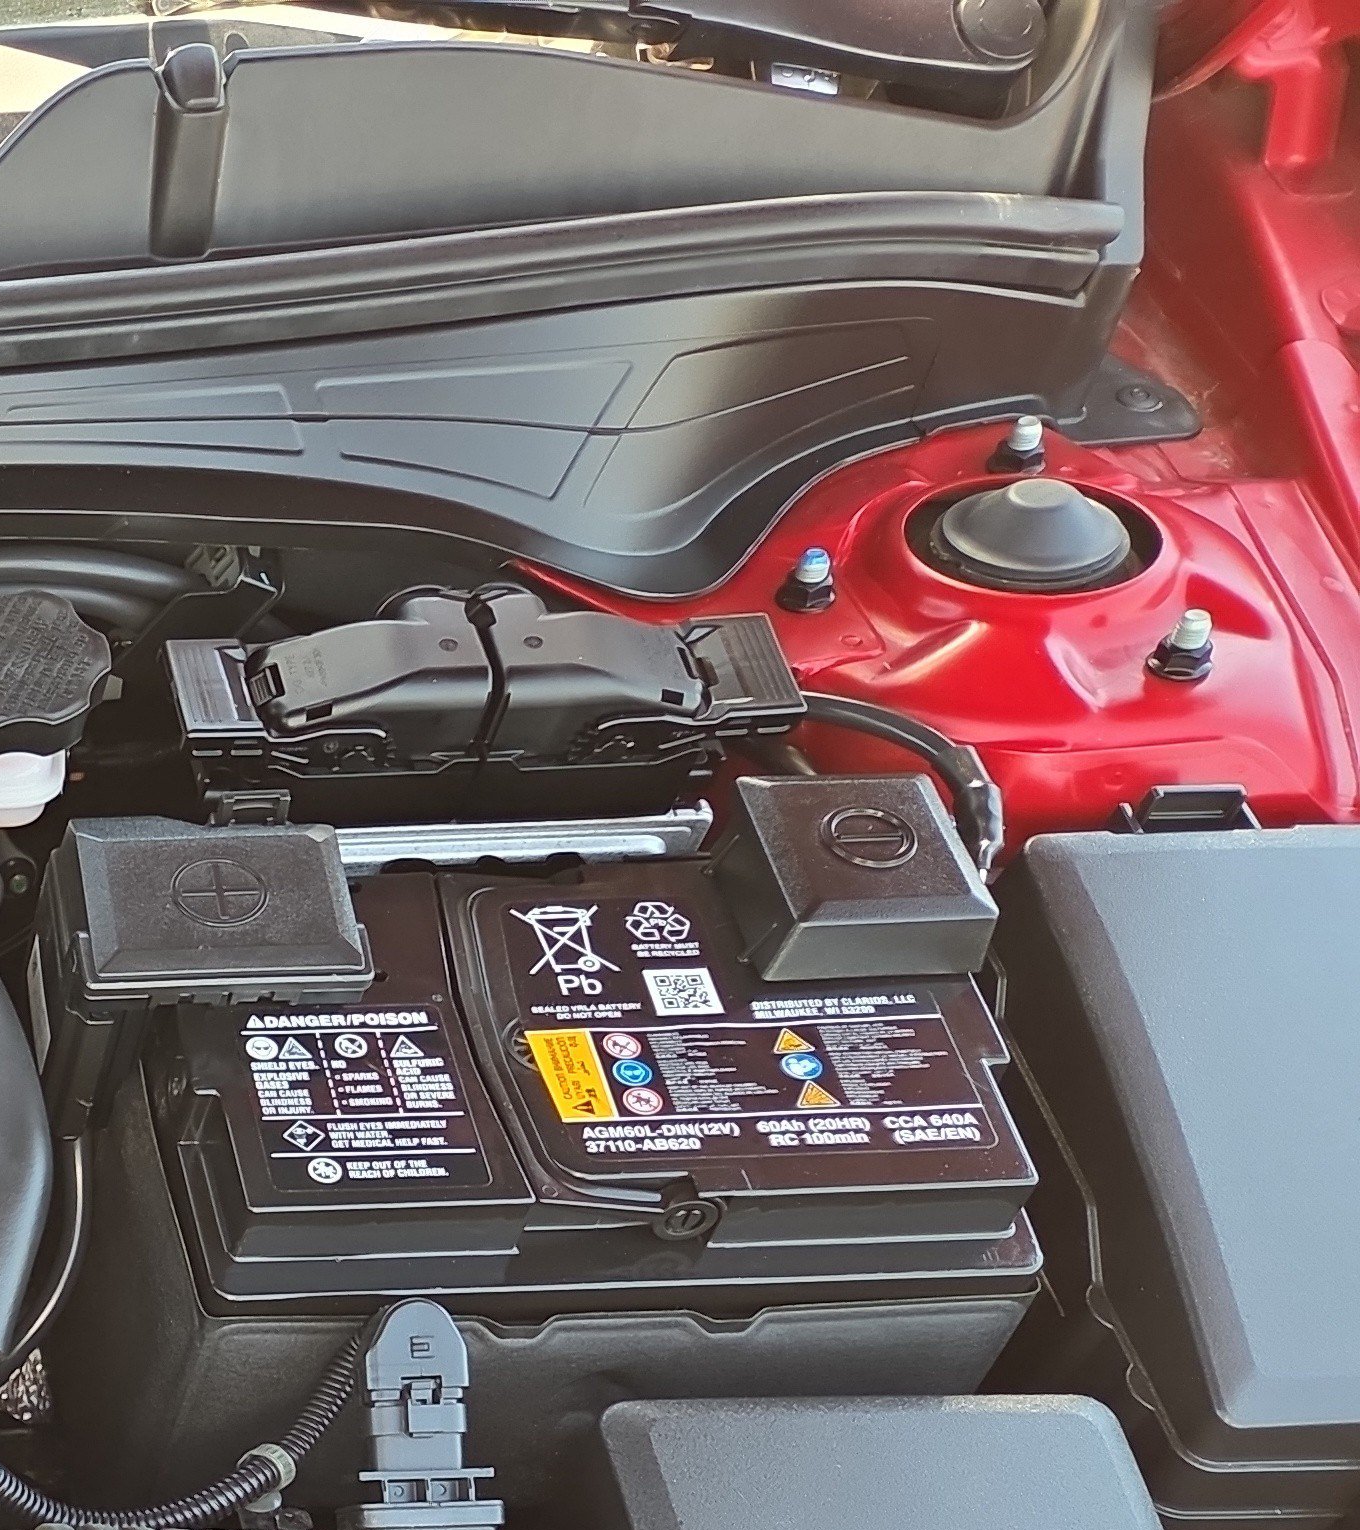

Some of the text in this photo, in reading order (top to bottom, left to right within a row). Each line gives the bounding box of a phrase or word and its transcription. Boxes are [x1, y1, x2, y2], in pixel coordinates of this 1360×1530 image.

[652, 949, 701, 958] RECYCLED
[557, 974, 603, 996] Pb
[751, 999, 823, 1011] DISTRIBUTED
[825, 998, 839, 1007] BY
[895, 994, 917, 1004] LLC
[531, 1002, 642, 1014] SEALED VRLA BATTERY
[754, 1008, 824, 1020] MILWAUKEE,
[825, 1006, 841, 1016] WI
[263, 1011, 429, 1029] DANGER/POISON
[556, 1010, 623, 1020] DO NOT OPEN
[250, 1061, 320, 1071] SHIELD EYES.
[330, 1060, 347, 1069] NO
[393, 1057, 445, 1067] SULFURIC
[342, 1072, 380, 1081] SPARKS
[396, 1067, 422, 1076] ACID
[253, 1072, 310, 1082] EXPLOSIVE
[398, 1074, 451, 1084] CAN CAUSE
[345, 1084, 384, 1093] FLAMES
[401, 1082, 454, 1092] BLINDNESS
[257, 1088, 310, 1098] CAN CAUSE
[404, 1091, 456, 1100] OR SEVERE
[260, 1098, 312, 1107] BLINDNESS
[348, 1097, 394, 1107] SMOKING
[262, 1106, 315, 1115] OR INJURY.
[326, 1119, 447, 1131] FLUSH EYES IMMEDIATELY
[755, 1117, 871, 1133] 60Ah (20HR)
[881, 1113, 979, 1129] CCA 640A
[329, 1130, 393, 1140] WITH WATER.
[582, 1122, 741, 1141] AGM60L-DIN(12V)
[892, 1127, 981, 1145] (SAE/EN)
[331, 1139, 350, 1148] GET
[352, 1138, 394, 1148] MEDICAL
[395, 1137, 420, 1147] HELP
[768, 1131, 871, 1148] RC 100min
[584, 1138, 702, 1154] 37110-AB620
[346, 1160, 428, 1170] KEEP OUT OF THE
[349, 1168, 450, 1179] REACH OF CHILDREN.
